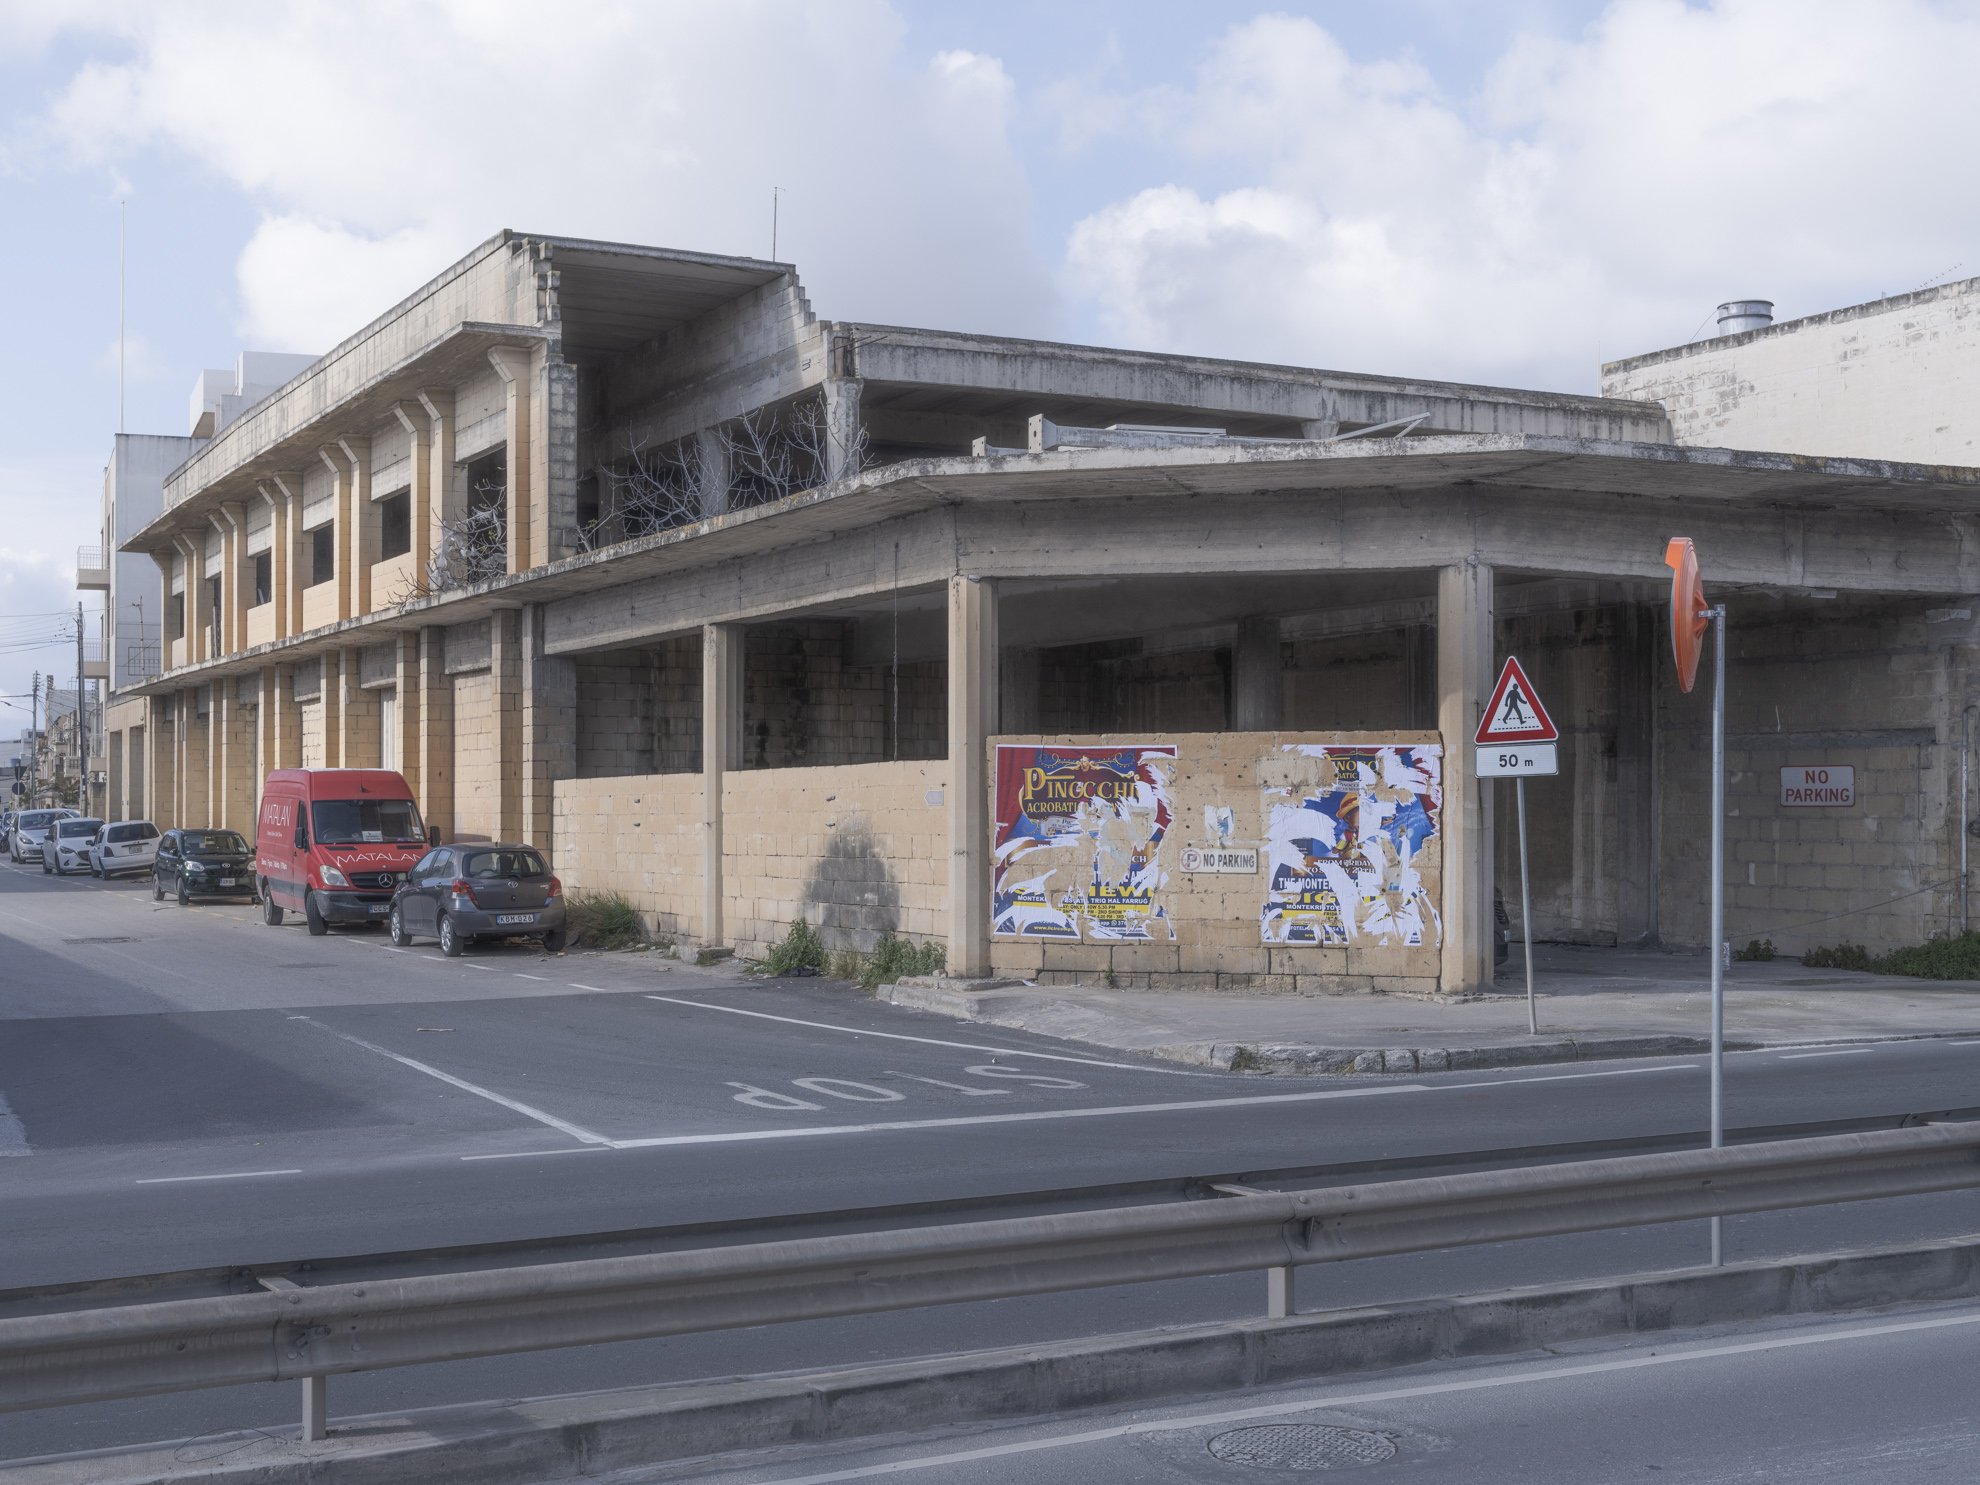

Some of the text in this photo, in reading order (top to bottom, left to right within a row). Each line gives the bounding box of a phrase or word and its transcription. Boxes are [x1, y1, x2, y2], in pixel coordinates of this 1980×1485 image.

[1499, 754, 1518, 767] 50
[1023, 767, 1140, 800] PINOCCHI
[1805, 770, 1828, 784] NO
[1785, 788, 1850, 802] PARKING
[1026, 801, 1081, 813] ACROBATI
[263, 804, 291, 826] MATALAN
[1203, 854, 1215, 867] NO
[1218, 855, 1254, 868] PARKING
[725, 1065, 1090, 1111] STOP
